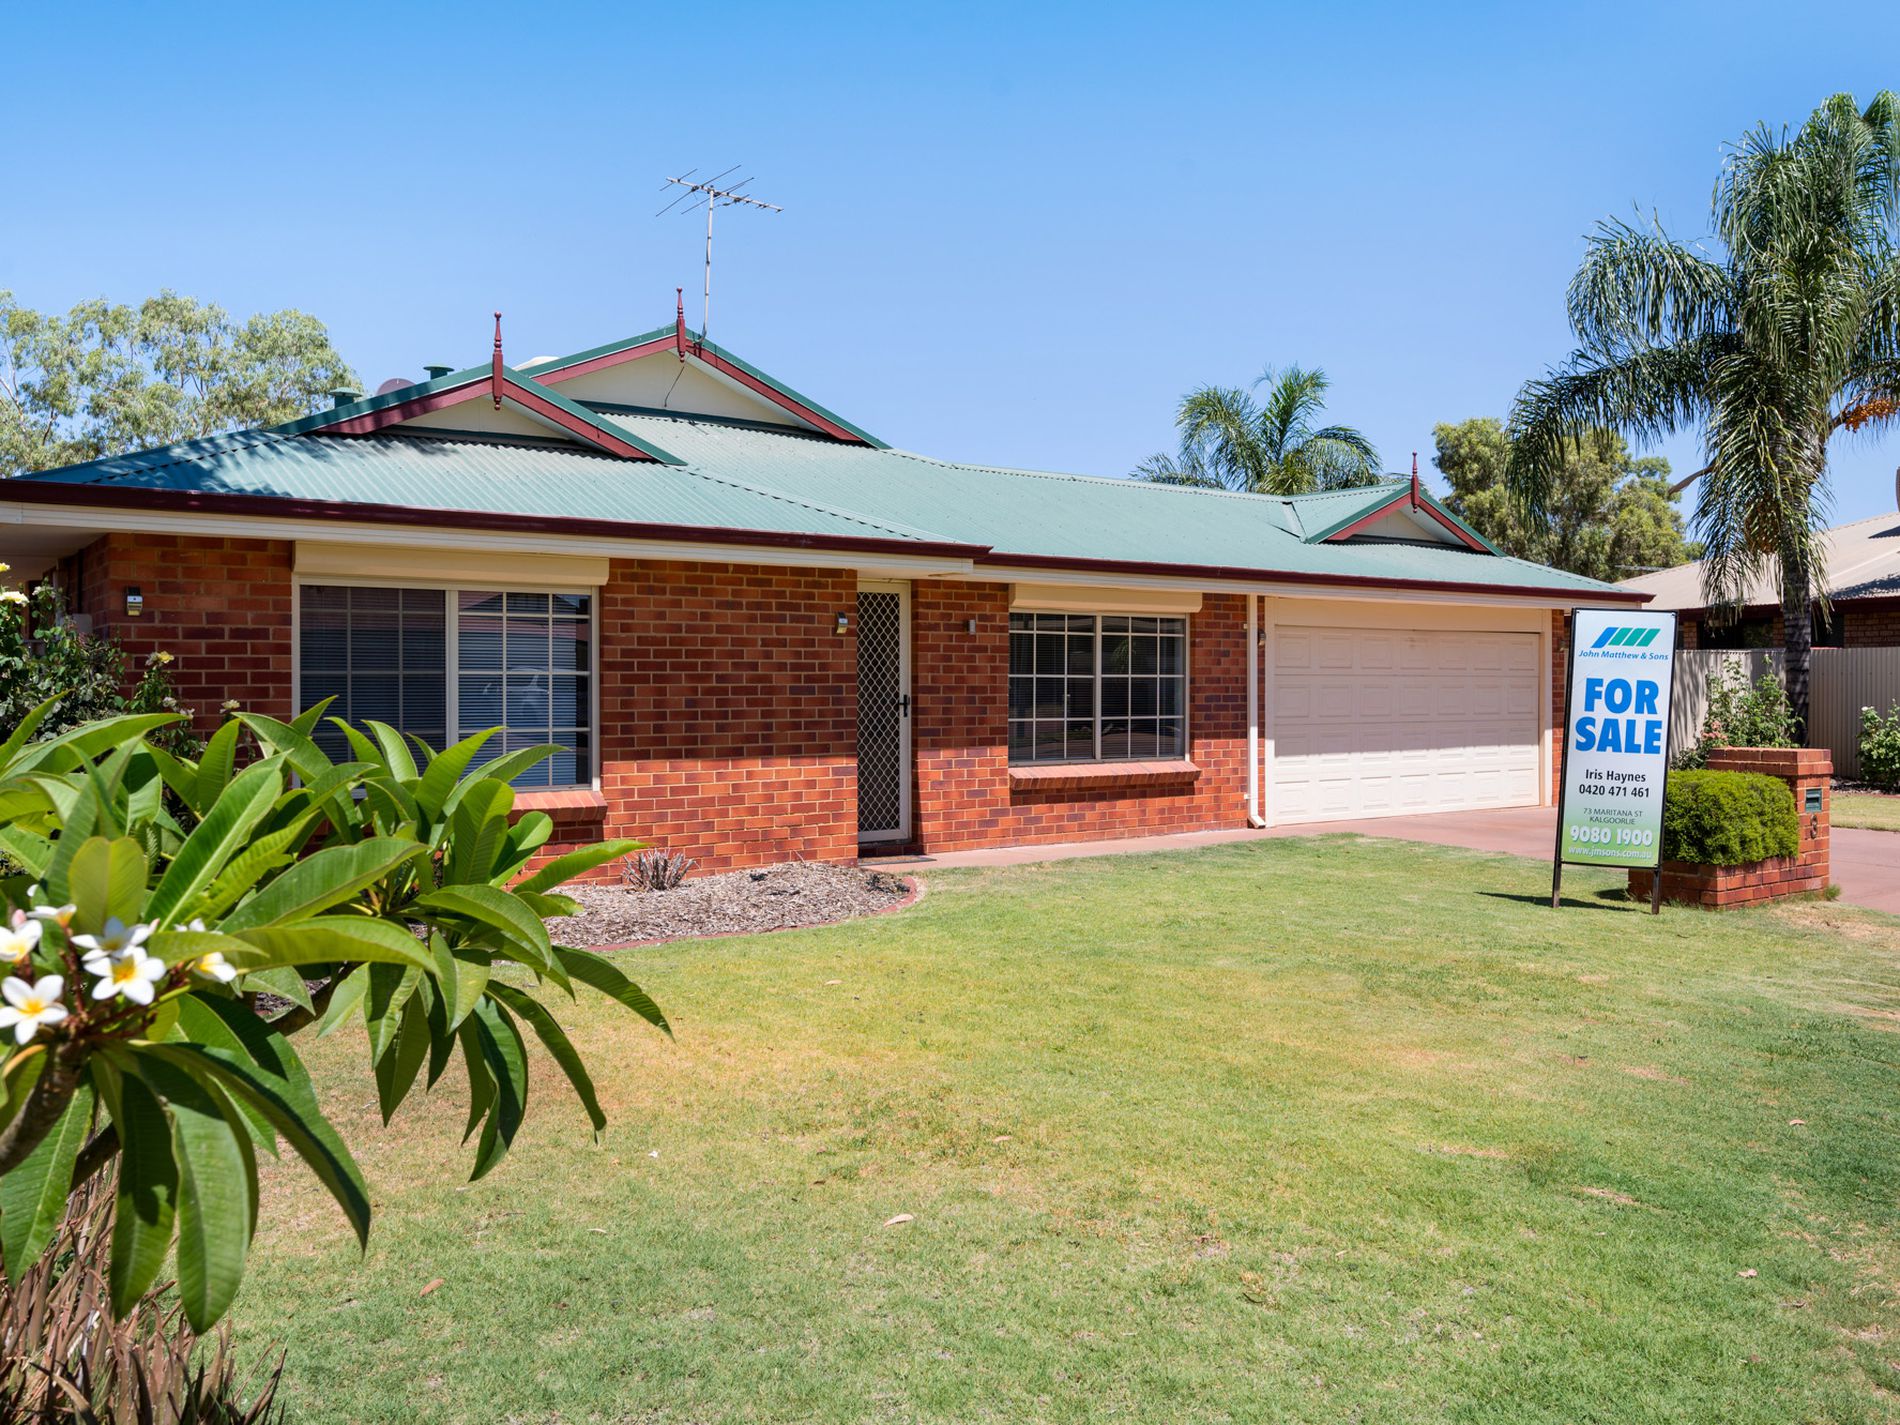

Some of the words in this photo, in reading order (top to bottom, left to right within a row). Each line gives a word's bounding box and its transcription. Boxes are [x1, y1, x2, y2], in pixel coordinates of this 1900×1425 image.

[1578, 650, 1599, 658] John
[1601, 651, 1639, 659] Matthew
[1640, 652, 1647, 660] &
[1649, 652, 1669, 660] Sons
[1584, 677, 1659, 714] FOR
[1575, 716, 1662, 754] SALE
[1585, 769, 1603, 780] Iris
[1606, 770, 1646, 784] Haynes
[1579, 784, 1605, 796] 0420
[1608, 786, 1627, 797] 471
[1631, 787, 1649, 798] 461
[1593, 808, 1633, 817] MARITANA
[1634, 810, 1643, 818] ST
[1589, 816, 1636, 825] KALGOORLIE
[1570, 825, 1611, 844] 9080
[1616, 828, 1653, 847] 1900
[1568, 845, 1653, 859] www.jmsons.com.au
